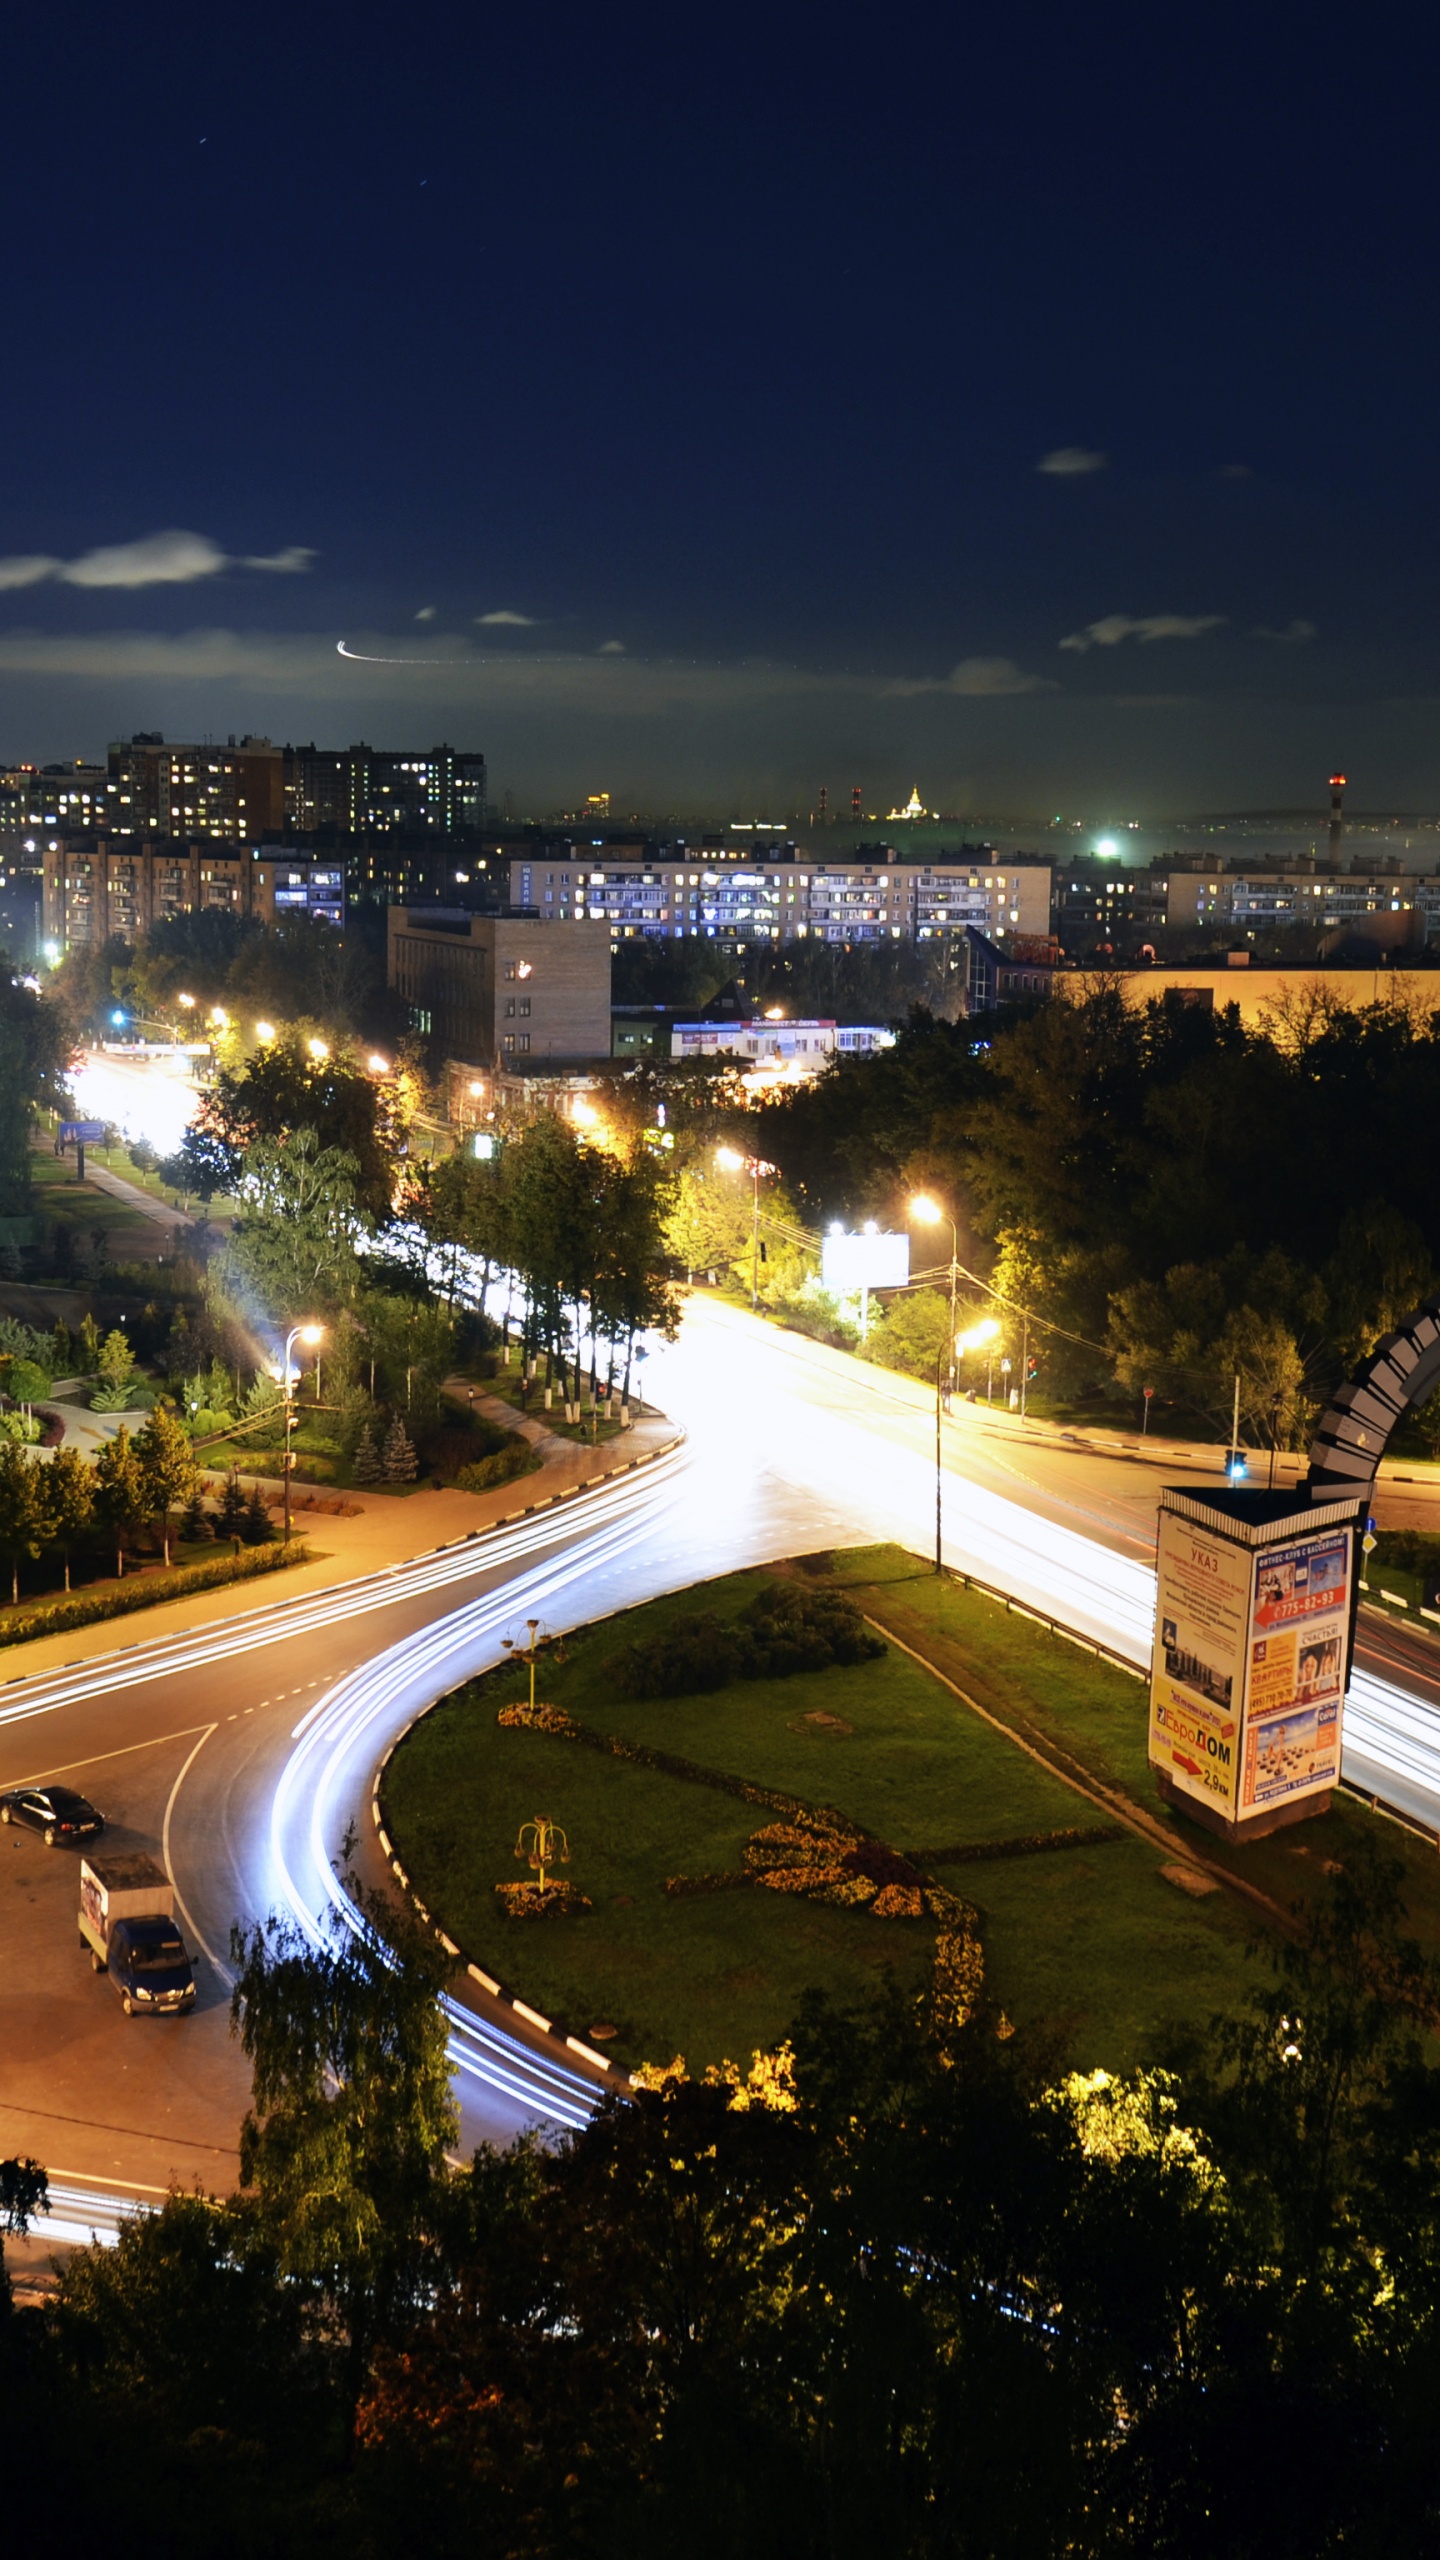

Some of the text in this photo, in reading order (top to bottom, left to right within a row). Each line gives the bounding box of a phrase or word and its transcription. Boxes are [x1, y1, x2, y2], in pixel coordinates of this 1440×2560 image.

[1191, 1547, 1218, 1572] УКАЗ
[1259, 1550, 1301, 1567] ФИТНЕС-КЛУБ
[1281, 1590, 1334, 1617] 775-82-93
